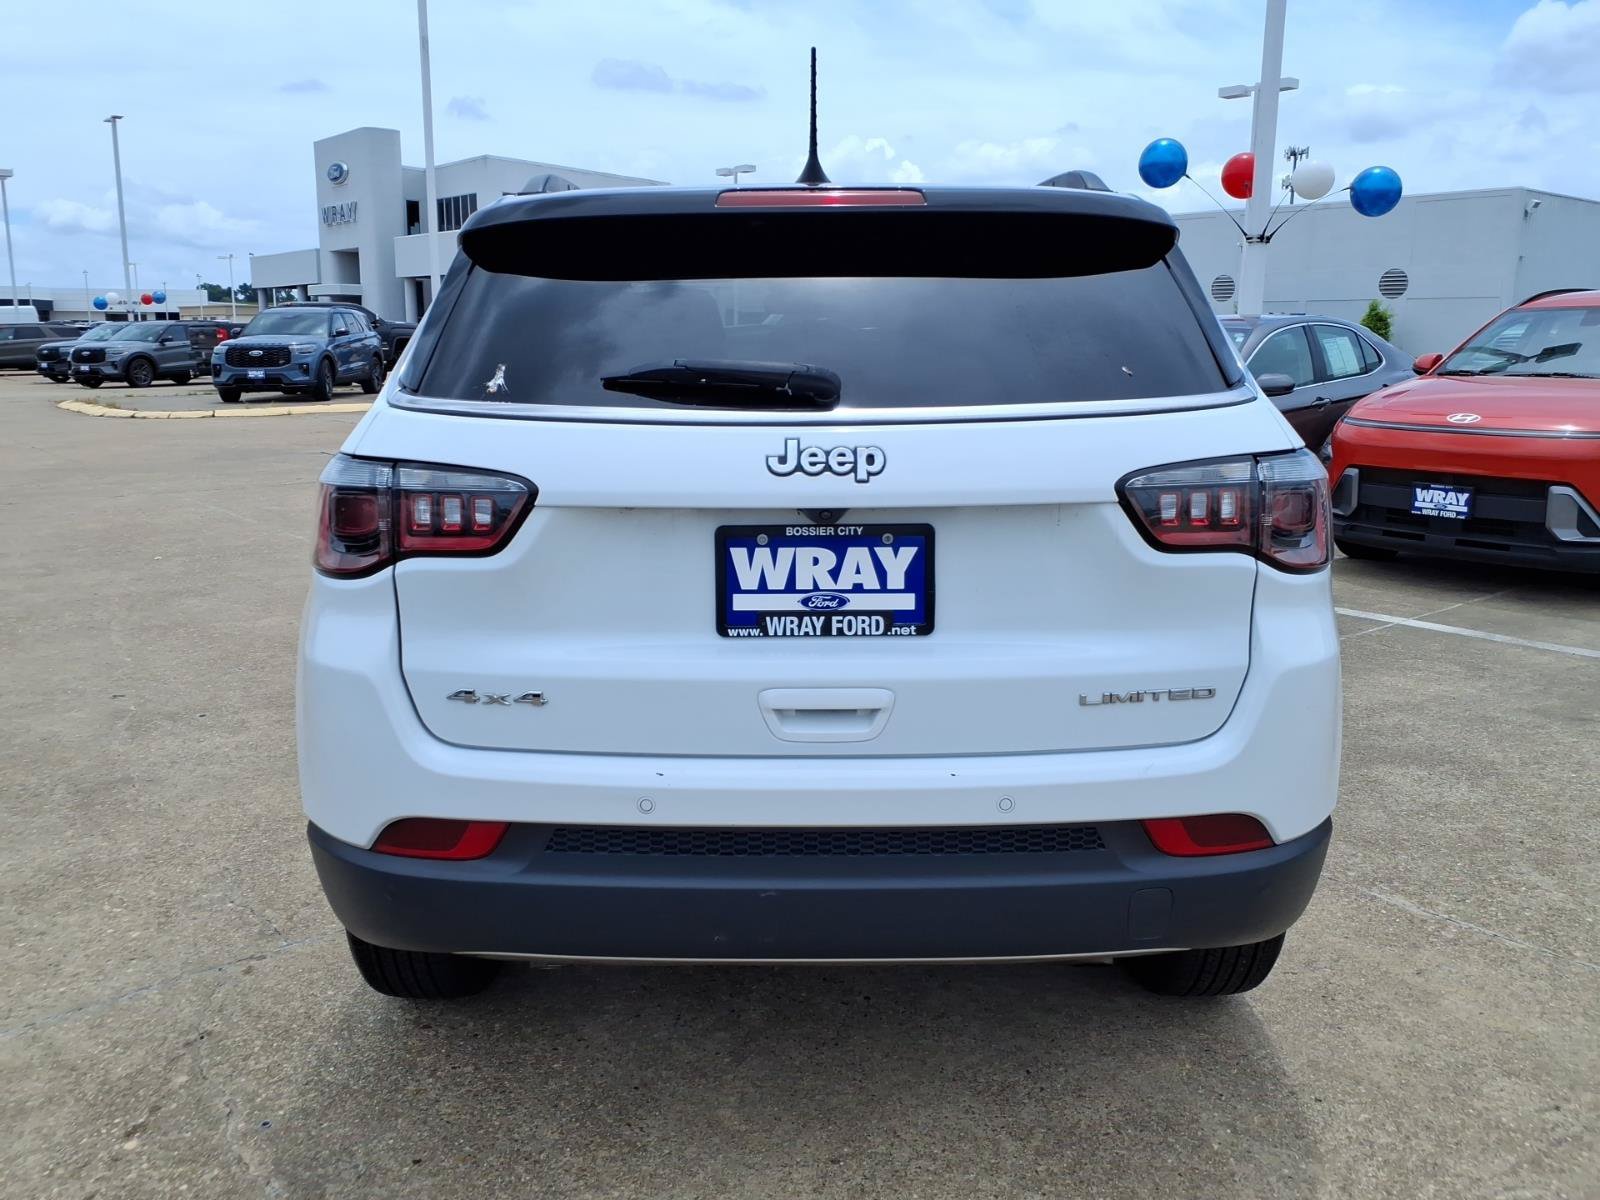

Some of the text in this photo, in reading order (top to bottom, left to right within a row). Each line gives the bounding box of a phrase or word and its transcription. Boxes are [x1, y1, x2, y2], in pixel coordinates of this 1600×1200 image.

[321, 200, 358, 227] WRAY
[766, 437, 887, 483] Jeep
[1416, 487, 1470, 506] WRAY
[1421, 508, 1440, 517] WRAY
[785, 526, 864, 537] BOSSIER CITY
[729, 546, 919, 591] WRAY
[808, 595, 840, 608] Ford
[727, 615, 917, 637] www. WRAY FORD .net
[446, 688, 549, 706] 4x4
[1079, 687, 1217, 706] LIMITED
